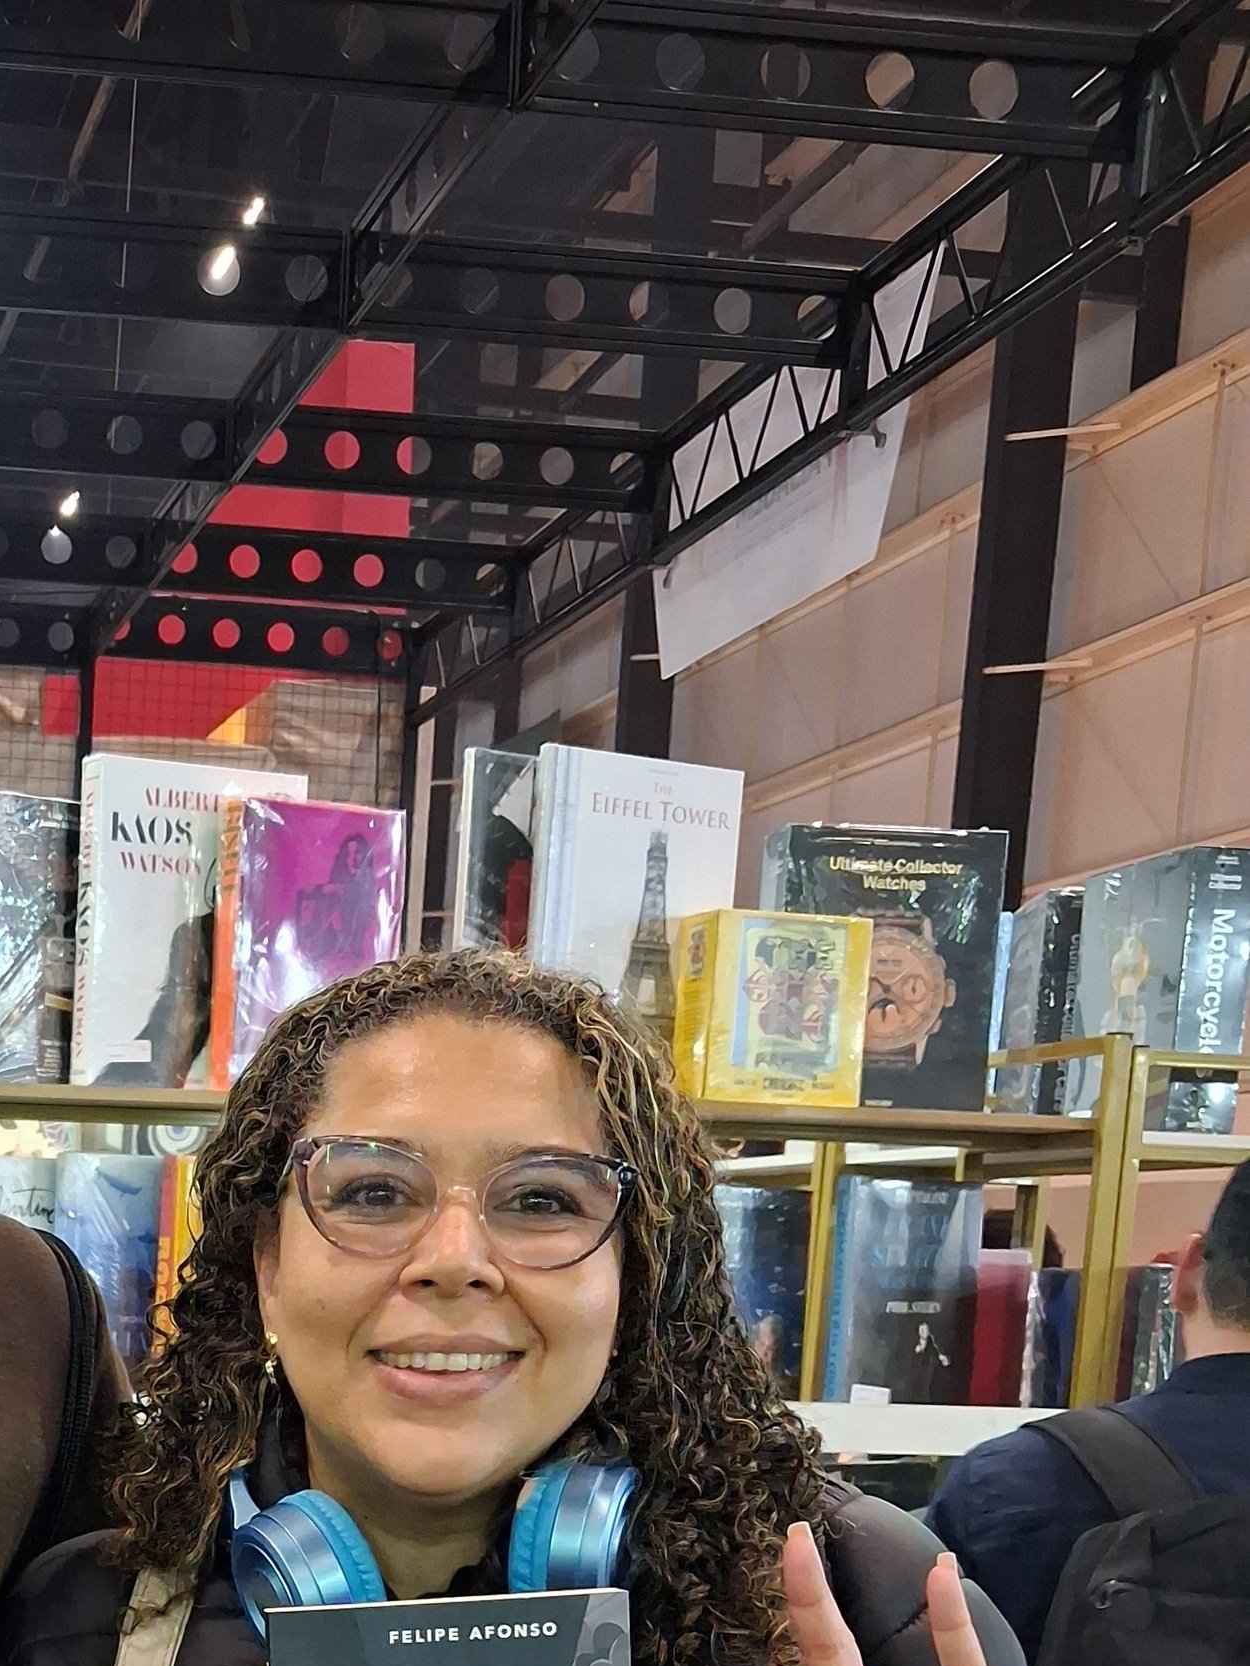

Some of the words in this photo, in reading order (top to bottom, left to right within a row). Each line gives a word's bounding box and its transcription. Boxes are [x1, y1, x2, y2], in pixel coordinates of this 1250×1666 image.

[592, 792, 653, 820] EIFFEL
[660, 801, 730, 830] TOWER
[111, 811, 193, 847] KAOS
[120, 852, 202, 877] WATSON
[863, 874, 926, 892] Watches
[388, 1626, 461, 1646] FELIPE
[468, 1621, 559, 1641] AFONSO
